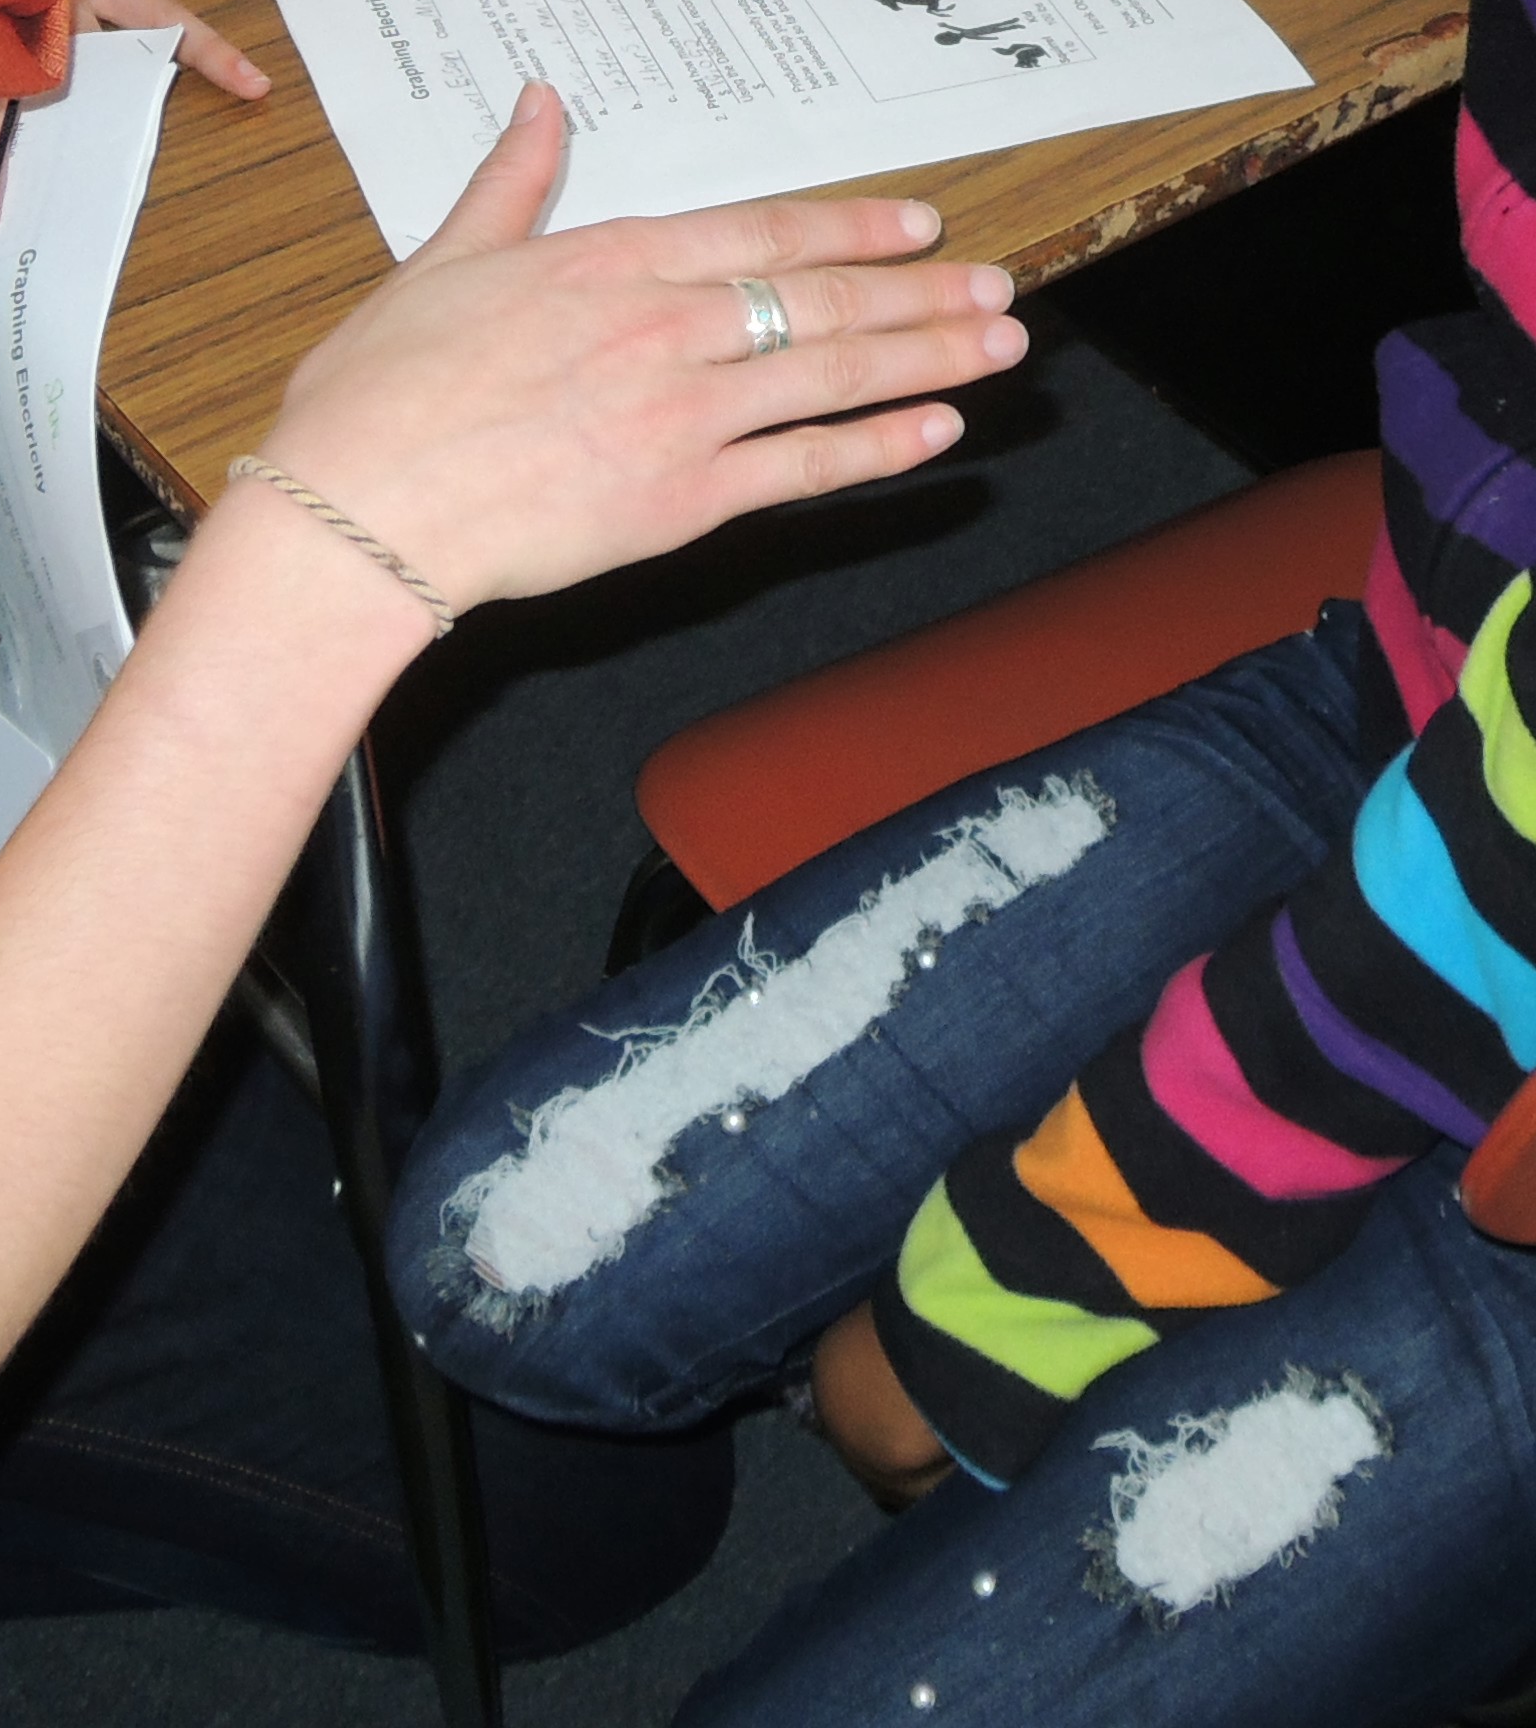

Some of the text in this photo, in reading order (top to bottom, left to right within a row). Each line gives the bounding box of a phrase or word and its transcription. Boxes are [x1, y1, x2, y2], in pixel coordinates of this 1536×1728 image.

[482, 9, 497, 19] of
[504, 11, 518, 24] it's
[651, 8, 674, 37] Oberlin
[783, 13, 797, 25] far
[1083, 10, 1105, 31] think
[489, 18, 508, 39] track
[514, 27, 529, 44] why
[748, 15, 778, 51] electricity
[769, 18, 787, 34] you
[791, 24, 805, 35] so
[501, 39, 519, 60] keep
[668, 36, 688, 60] much
[780, 35, 797, 53] help
[797, 35, 828, 70] released
[391, 39, 429, 100] Graphing
[512, 60, 525, 70] to
[525, 47, 548, 80] reasons
[683, 60, 700, 78] how
[792, 54, 805, 64] to
[723, 64, 739, 78] the
[773, 51, 805, 93] Producing
[801, 65, 822, 90] below
[822, 70, 839, 87] has
[693, 77, 720, 109] Predict
[733, 78, 754, 103] Using
[8, 247, 38, 363] Graphing
[13, 367, 49, 496] Electricity
